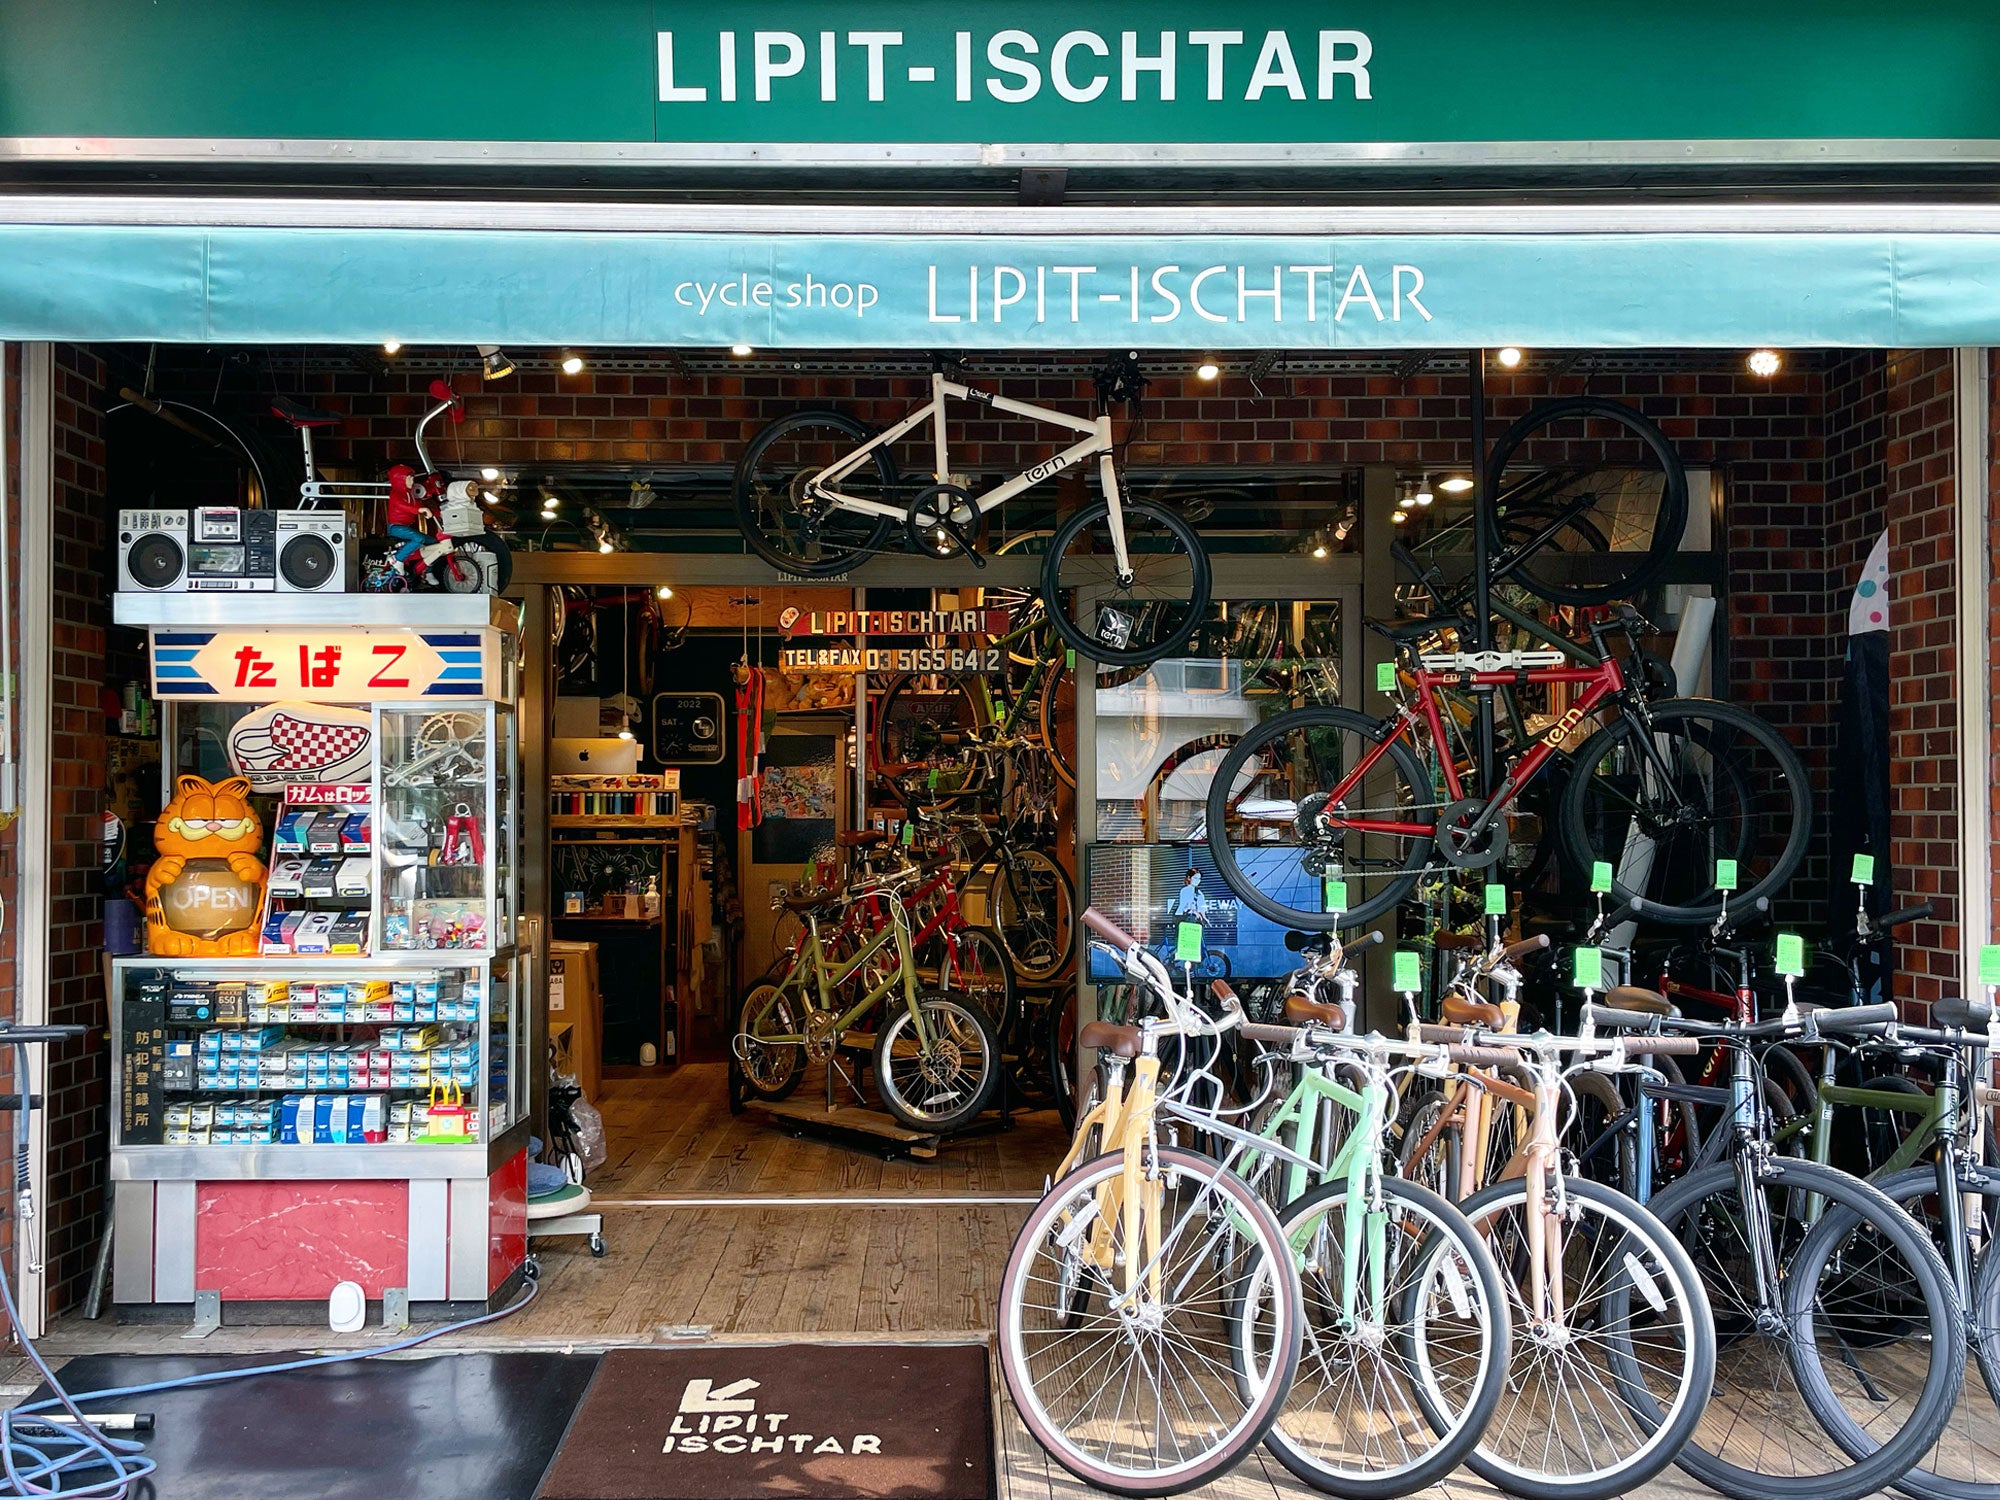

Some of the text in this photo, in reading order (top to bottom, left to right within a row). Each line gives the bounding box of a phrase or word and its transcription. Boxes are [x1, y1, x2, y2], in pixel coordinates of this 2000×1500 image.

[657, 30, 1374, 104] LIPIT-ISCHTAR
[674, 265, 1434, 325] cycle shop LIPIT-ISCHTAR
[1024, 455, 1066, 483] tern
[1100, 628, 1123, 645] tern
[233, 644, 410, 688] たばこ
[785, 649, 1000, 671] TEL&FAX 03 5155 6412
[677, 700, 701, 708] 2022
[661, 718, 678, 726] SAT
[1540, 707, 1586, 750] tern
[172, 884, 249, 910] OPEN
[218, 996, 236, 1004] 650
[134, 1030, 150, 1127] 防犯登録所
[669, 1413, 790, 1434] LIPIT
[662, 1434, 882, 1455] ISCHTAR
